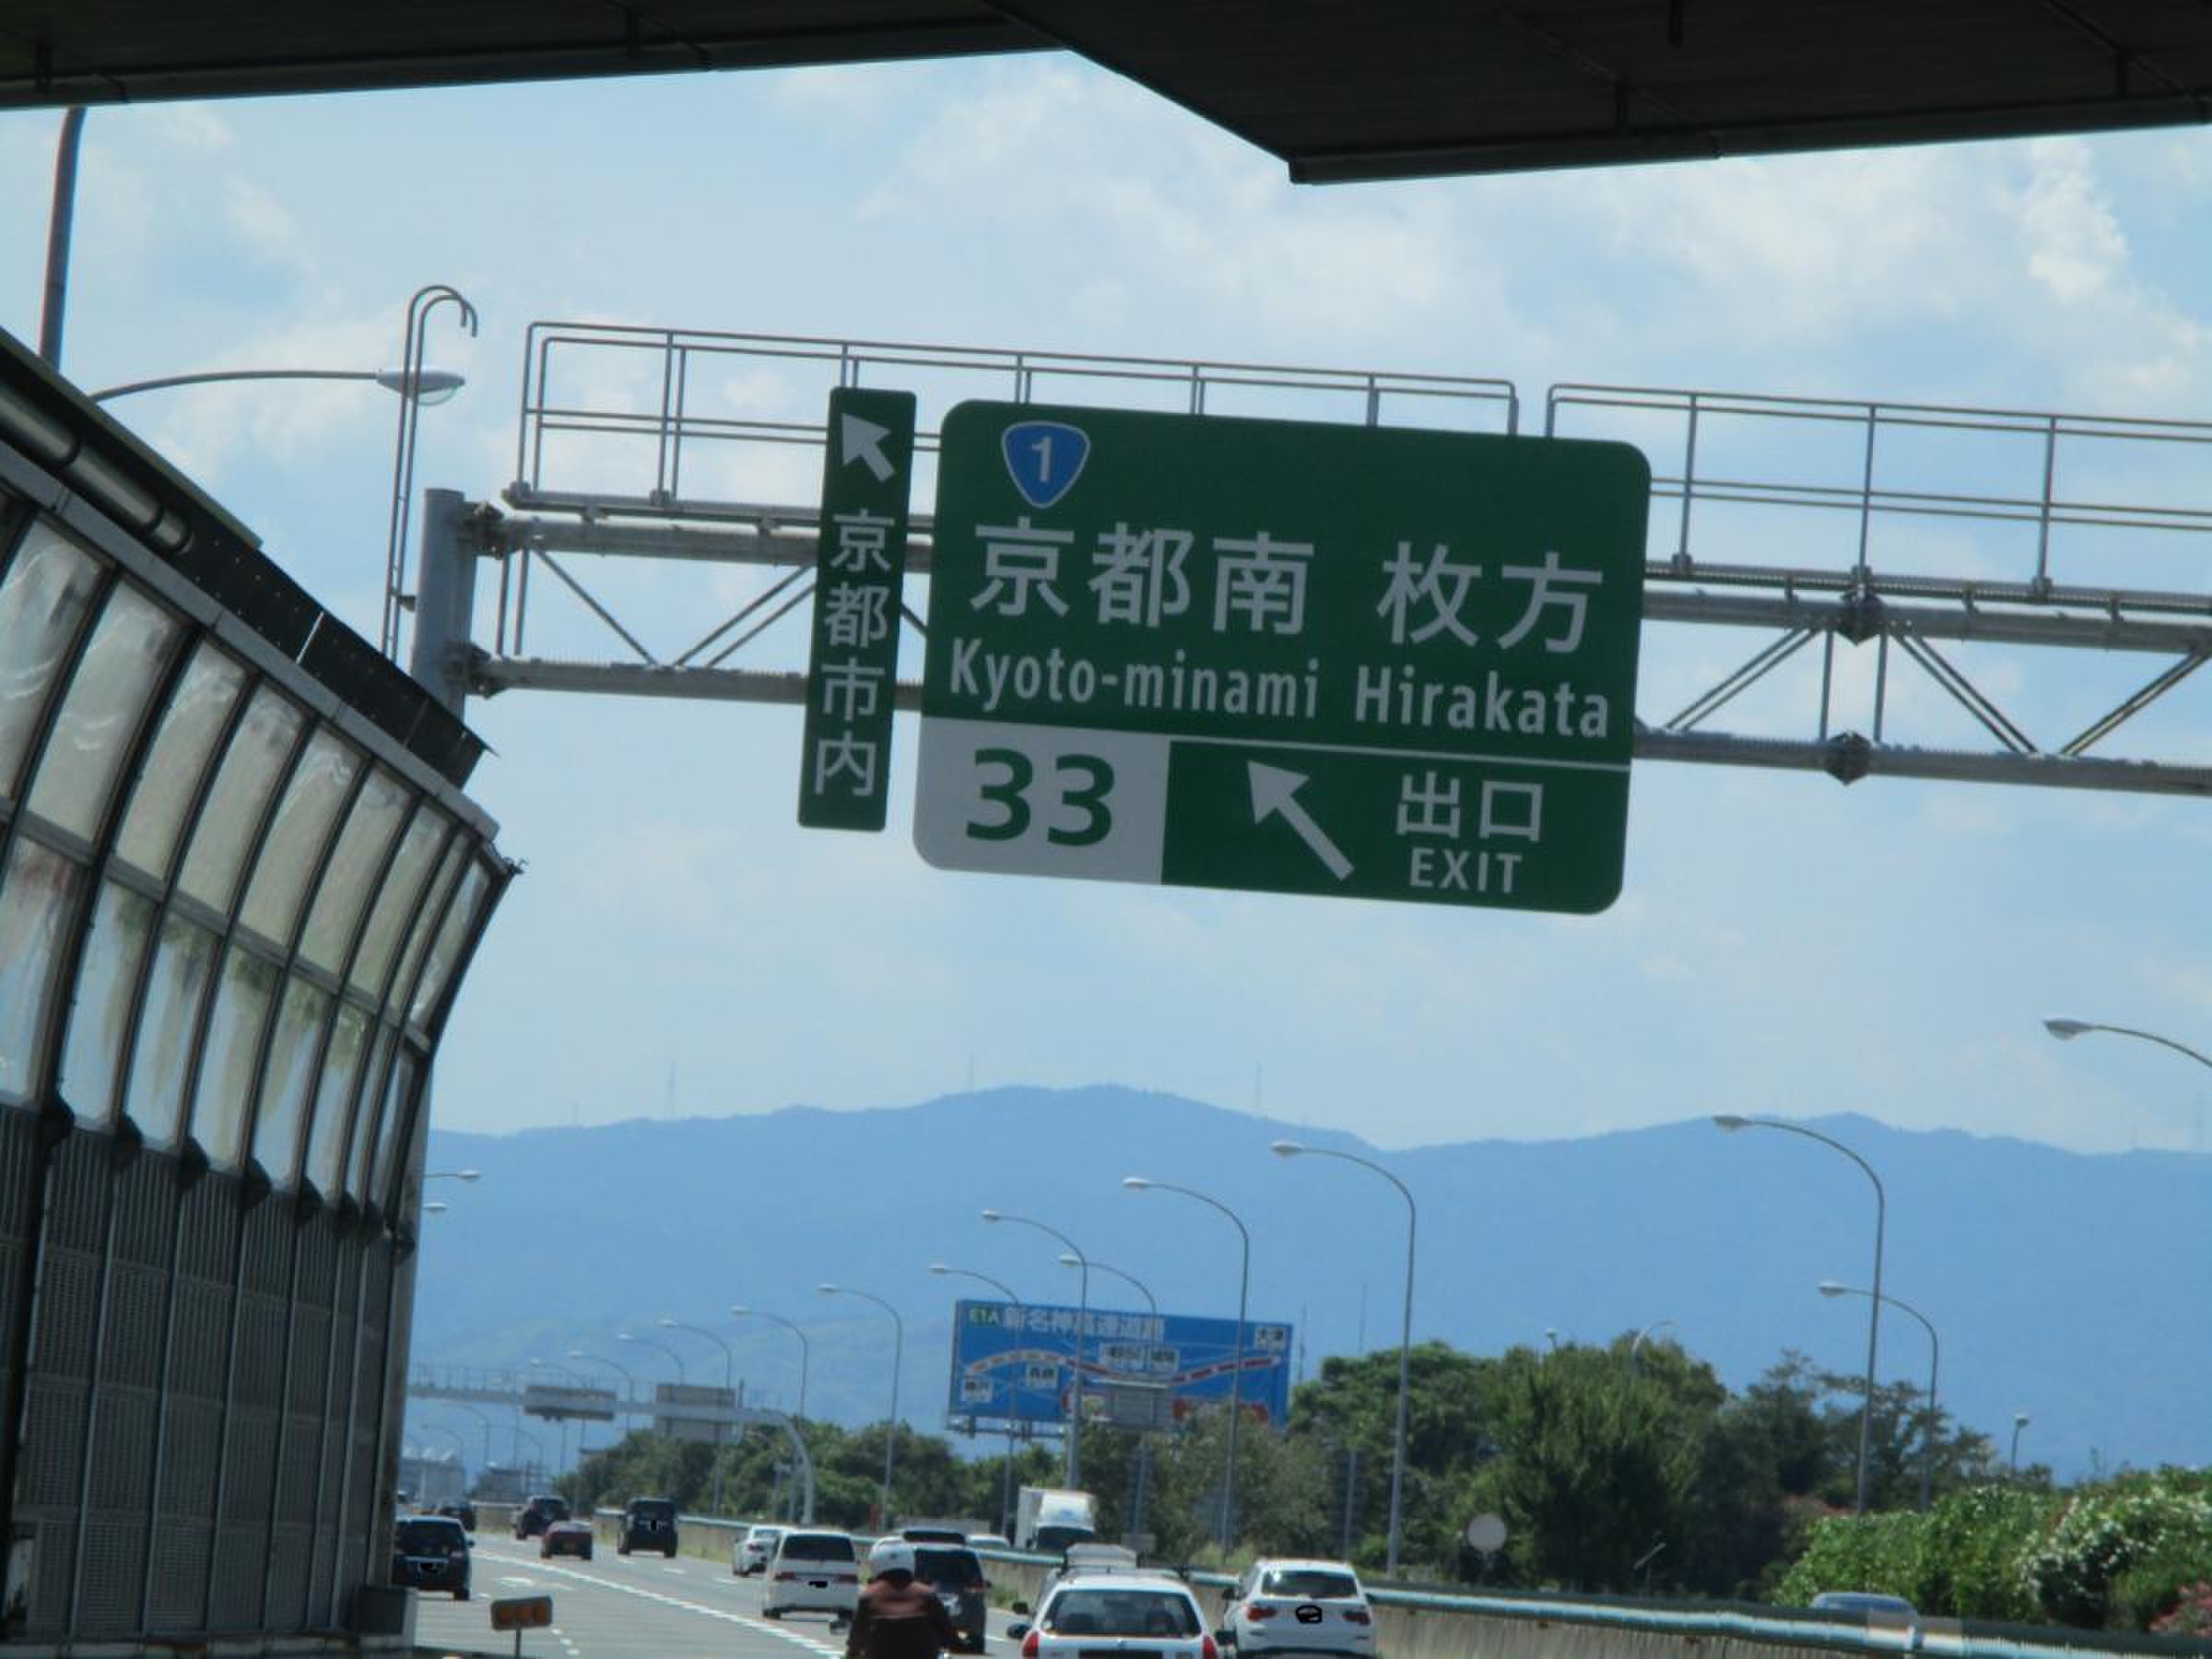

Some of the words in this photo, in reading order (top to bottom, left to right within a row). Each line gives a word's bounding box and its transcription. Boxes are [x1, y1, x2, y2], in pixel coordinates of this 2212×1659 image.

[1031, 435, 1053, 483] 1
[970, 515, 1314, 635] 京都南
[1376, 540, 1603, 654] 枚方
[814, 508, 895, 797] 京都市内
[949, 637, 1320, 719] Kyoto-minami
[1354, 665, 1609, 738] Hirakata
[966, 747, 1116, 847] 33
[1395, 771, 1544, 842] 出口
[1409, 847, 1523, 894] EXIT
